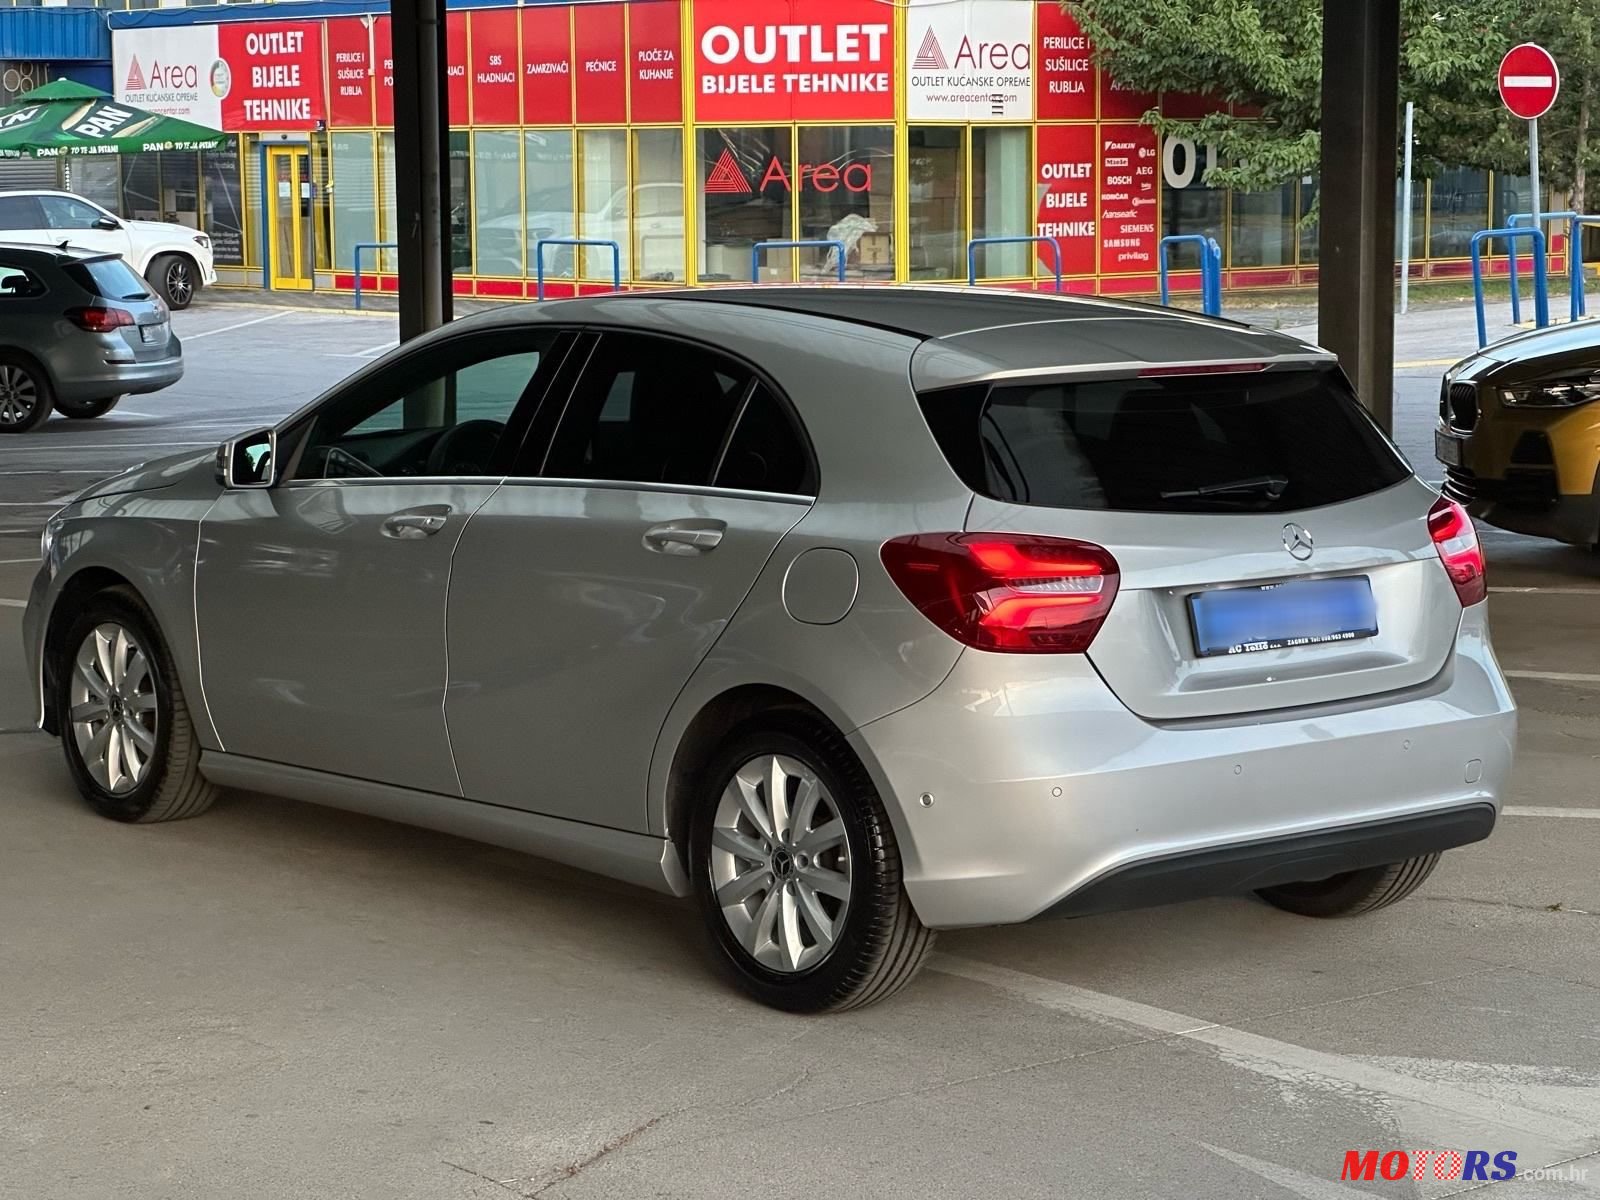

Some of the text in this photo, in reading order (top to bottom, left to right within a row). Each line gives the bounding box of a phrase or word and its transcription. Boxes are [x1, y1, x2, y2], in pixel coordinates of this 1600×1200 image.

[246, 31, 304, 56] OUTLET
[701, 24, 888, 64] OUTLET
[1043, 37, 1085, 49] PERILICE
[336, 52, 361, 63] PERILICE
[638, 49, 674, 62] PLOČE ZA
[953, 35, 1031, 70] Area
[489, 56, 502, 66] SBS
[526, 61, 569, 74] ZAMRZIVAČI
[585, 59, 617, 72] PEĆNICE
[1045, 56, 1089, 71] SUŠILICE
[150, 60, 198, 89] Area
[251, 65, 300, 88] BIJELE
[337, 68, 364, 80] SUŠILICE
[477, 72, 516, 84] HLADNJACI
[639, 68, 674, 81] KUHANJE
[702, 73, 888, 95] BIJELE TEHNIKE
[911, 74, 1031, 88] OUTLET KUĆANSKE OPREME
[1049, 81, 1085, 94] RUBLJA
[125, 94, 145, 103] OUTLET
[176, 92, 198, 102] OPREME
[340, 86, 362, 96] RUBLJA
[243, 98, 311, 122] TEHNIKE
[74, 106, 134, 138] PAN
[37, 147, 58, 157] PAN
[80, 146, 88, 154] TE
[142, 142, 164, 152] PAN
[174, 142, 183, 150] TO
[183, 142, 190, 150] TE
[760, 155, 872, 193] Area
[1041, 163, 1092, 179] OUTLET
[1136, 167, 1153, 175] AEG
[1107, 176, 1132, 185] BOSCH
[1045, 192, 1088, 208] BIJELE
[1102, 210, 1138, 218] hanseatic
[1038, 222, 1095, 238] TEHNIKE
[1120, 224, 1154, 233] SIEMENS
[1104, 238, 1140, 248] SAMSUNG
[1287, 638, 1309, 646] ZAGREB
